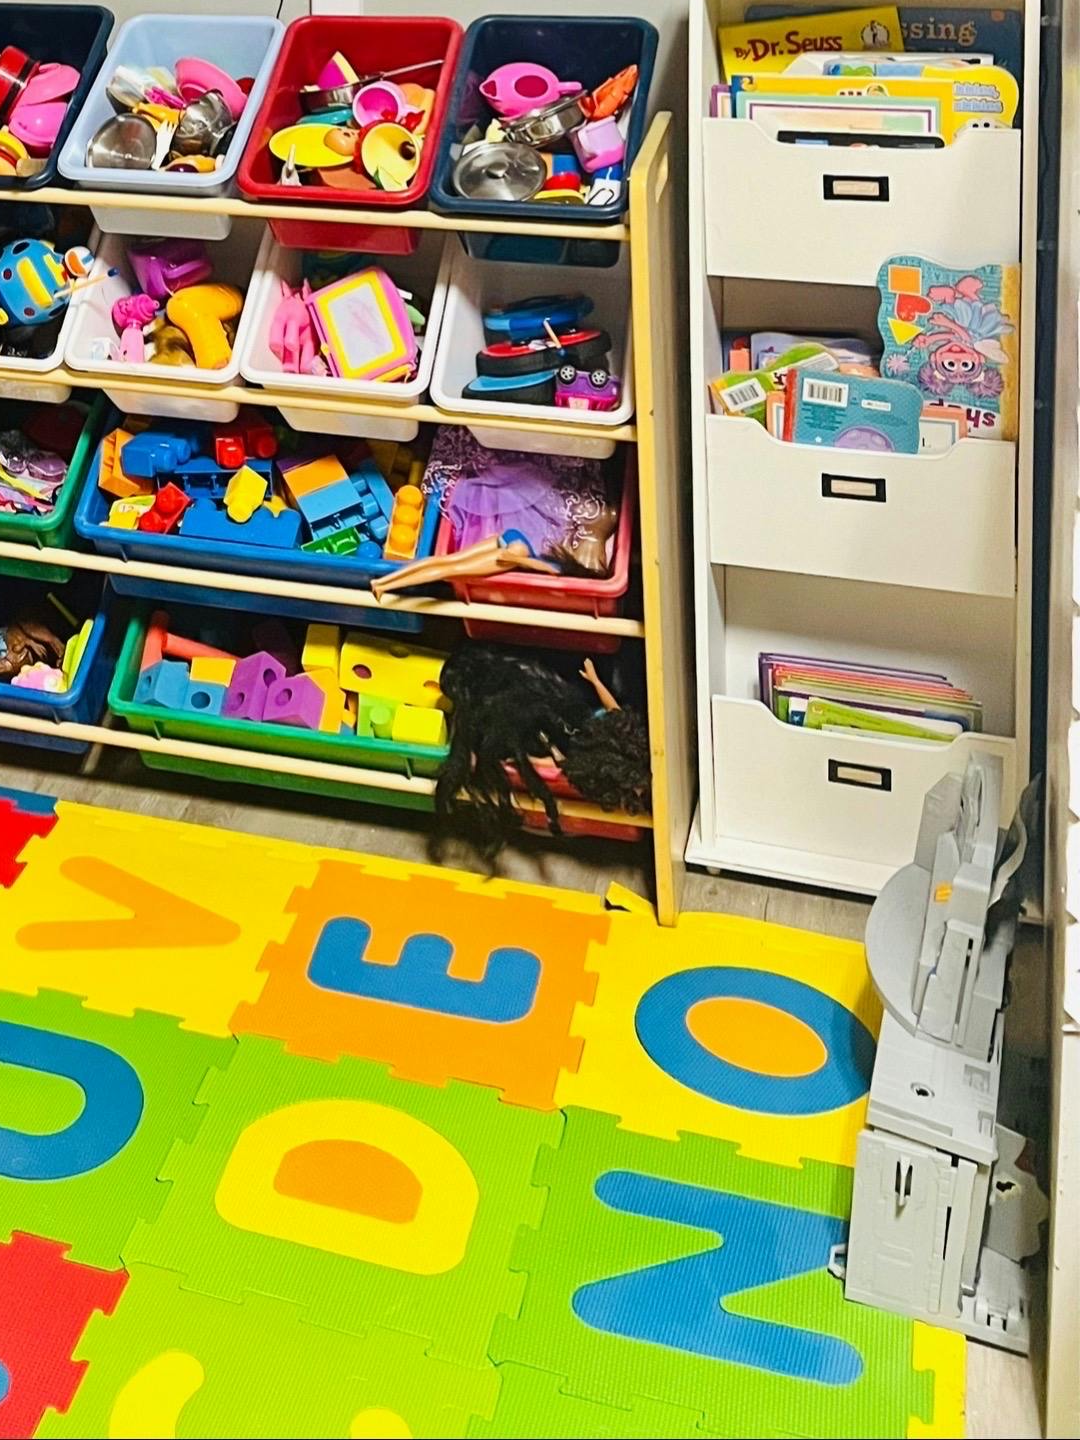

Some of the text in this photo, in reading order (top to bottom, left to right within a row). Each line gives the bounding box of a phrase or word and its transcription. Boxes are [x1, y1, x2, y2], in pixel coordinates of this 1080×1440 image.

[734, 31, 843, 62] By Dr. Seuss
[16, 856, 241, 951] V
[307, 916, 543, 1024] E
[635, 965, 878, 1115] O
[215, 1098, 478, 1276] D
